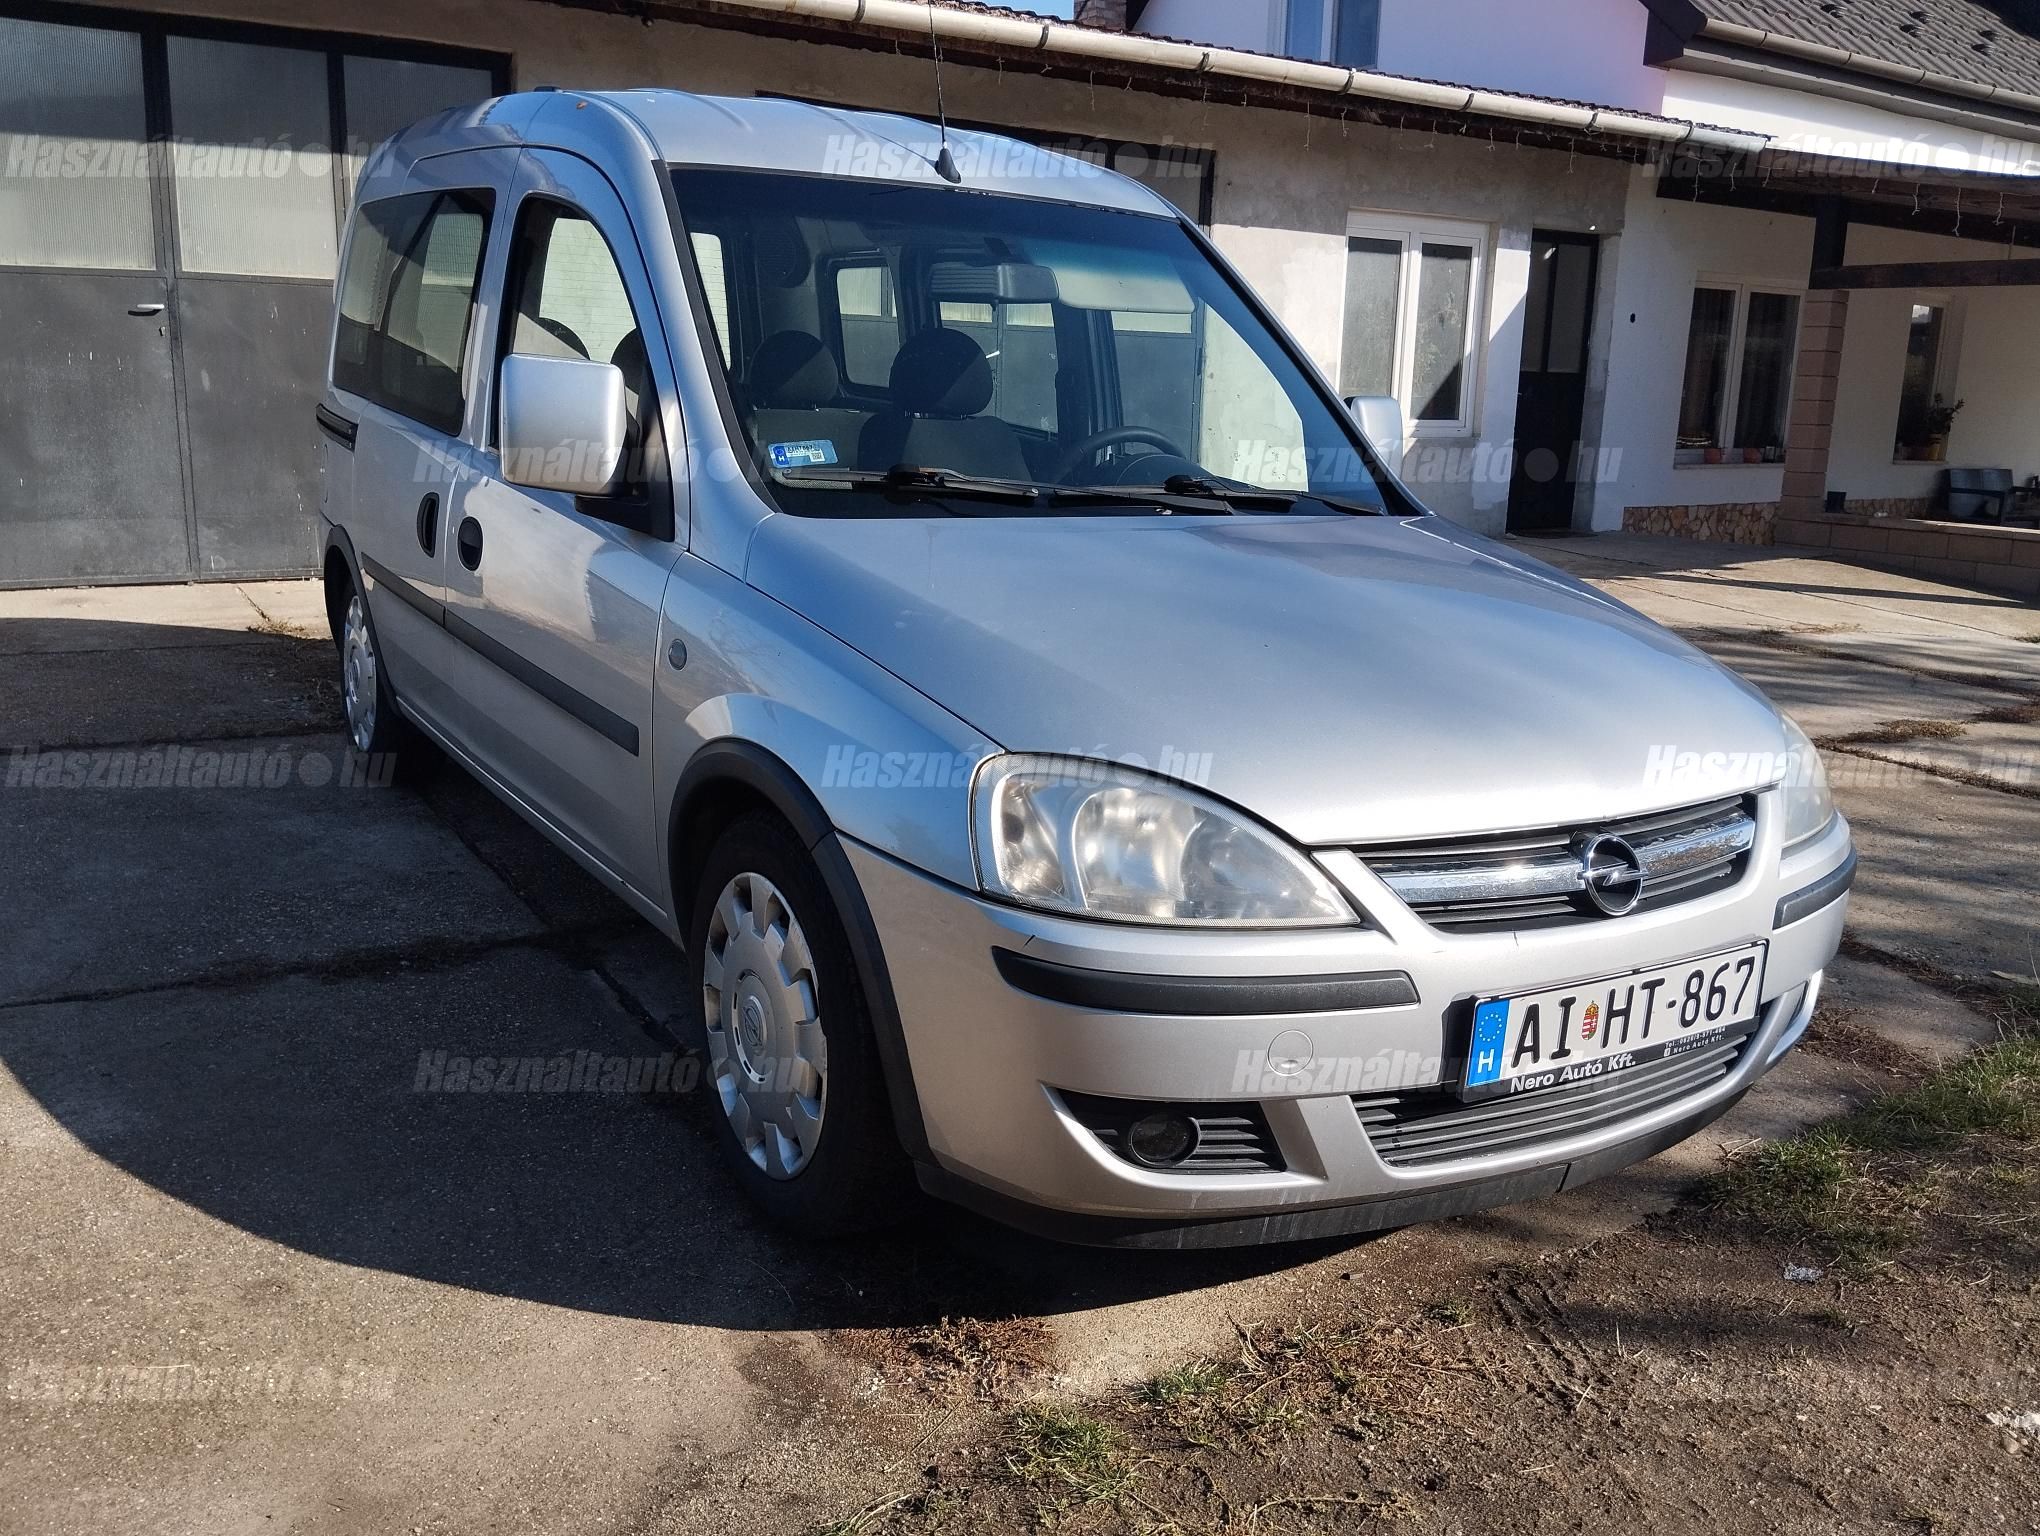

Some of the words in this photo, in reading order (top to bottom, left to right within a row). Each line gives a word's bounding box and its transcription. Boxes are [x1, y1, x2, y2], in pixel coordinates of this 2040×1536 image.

[1511, 996, 1577, 1068] AI
[1601, 956, 1756, 1048] HT-867
[1477, 1048, 1495, 1074] H
[1510, 1072, 1555, 1094] Nero
[1559, 1055, 1604, 1083] Autó
[1607, 1054, 1637, 1072] Kft.
